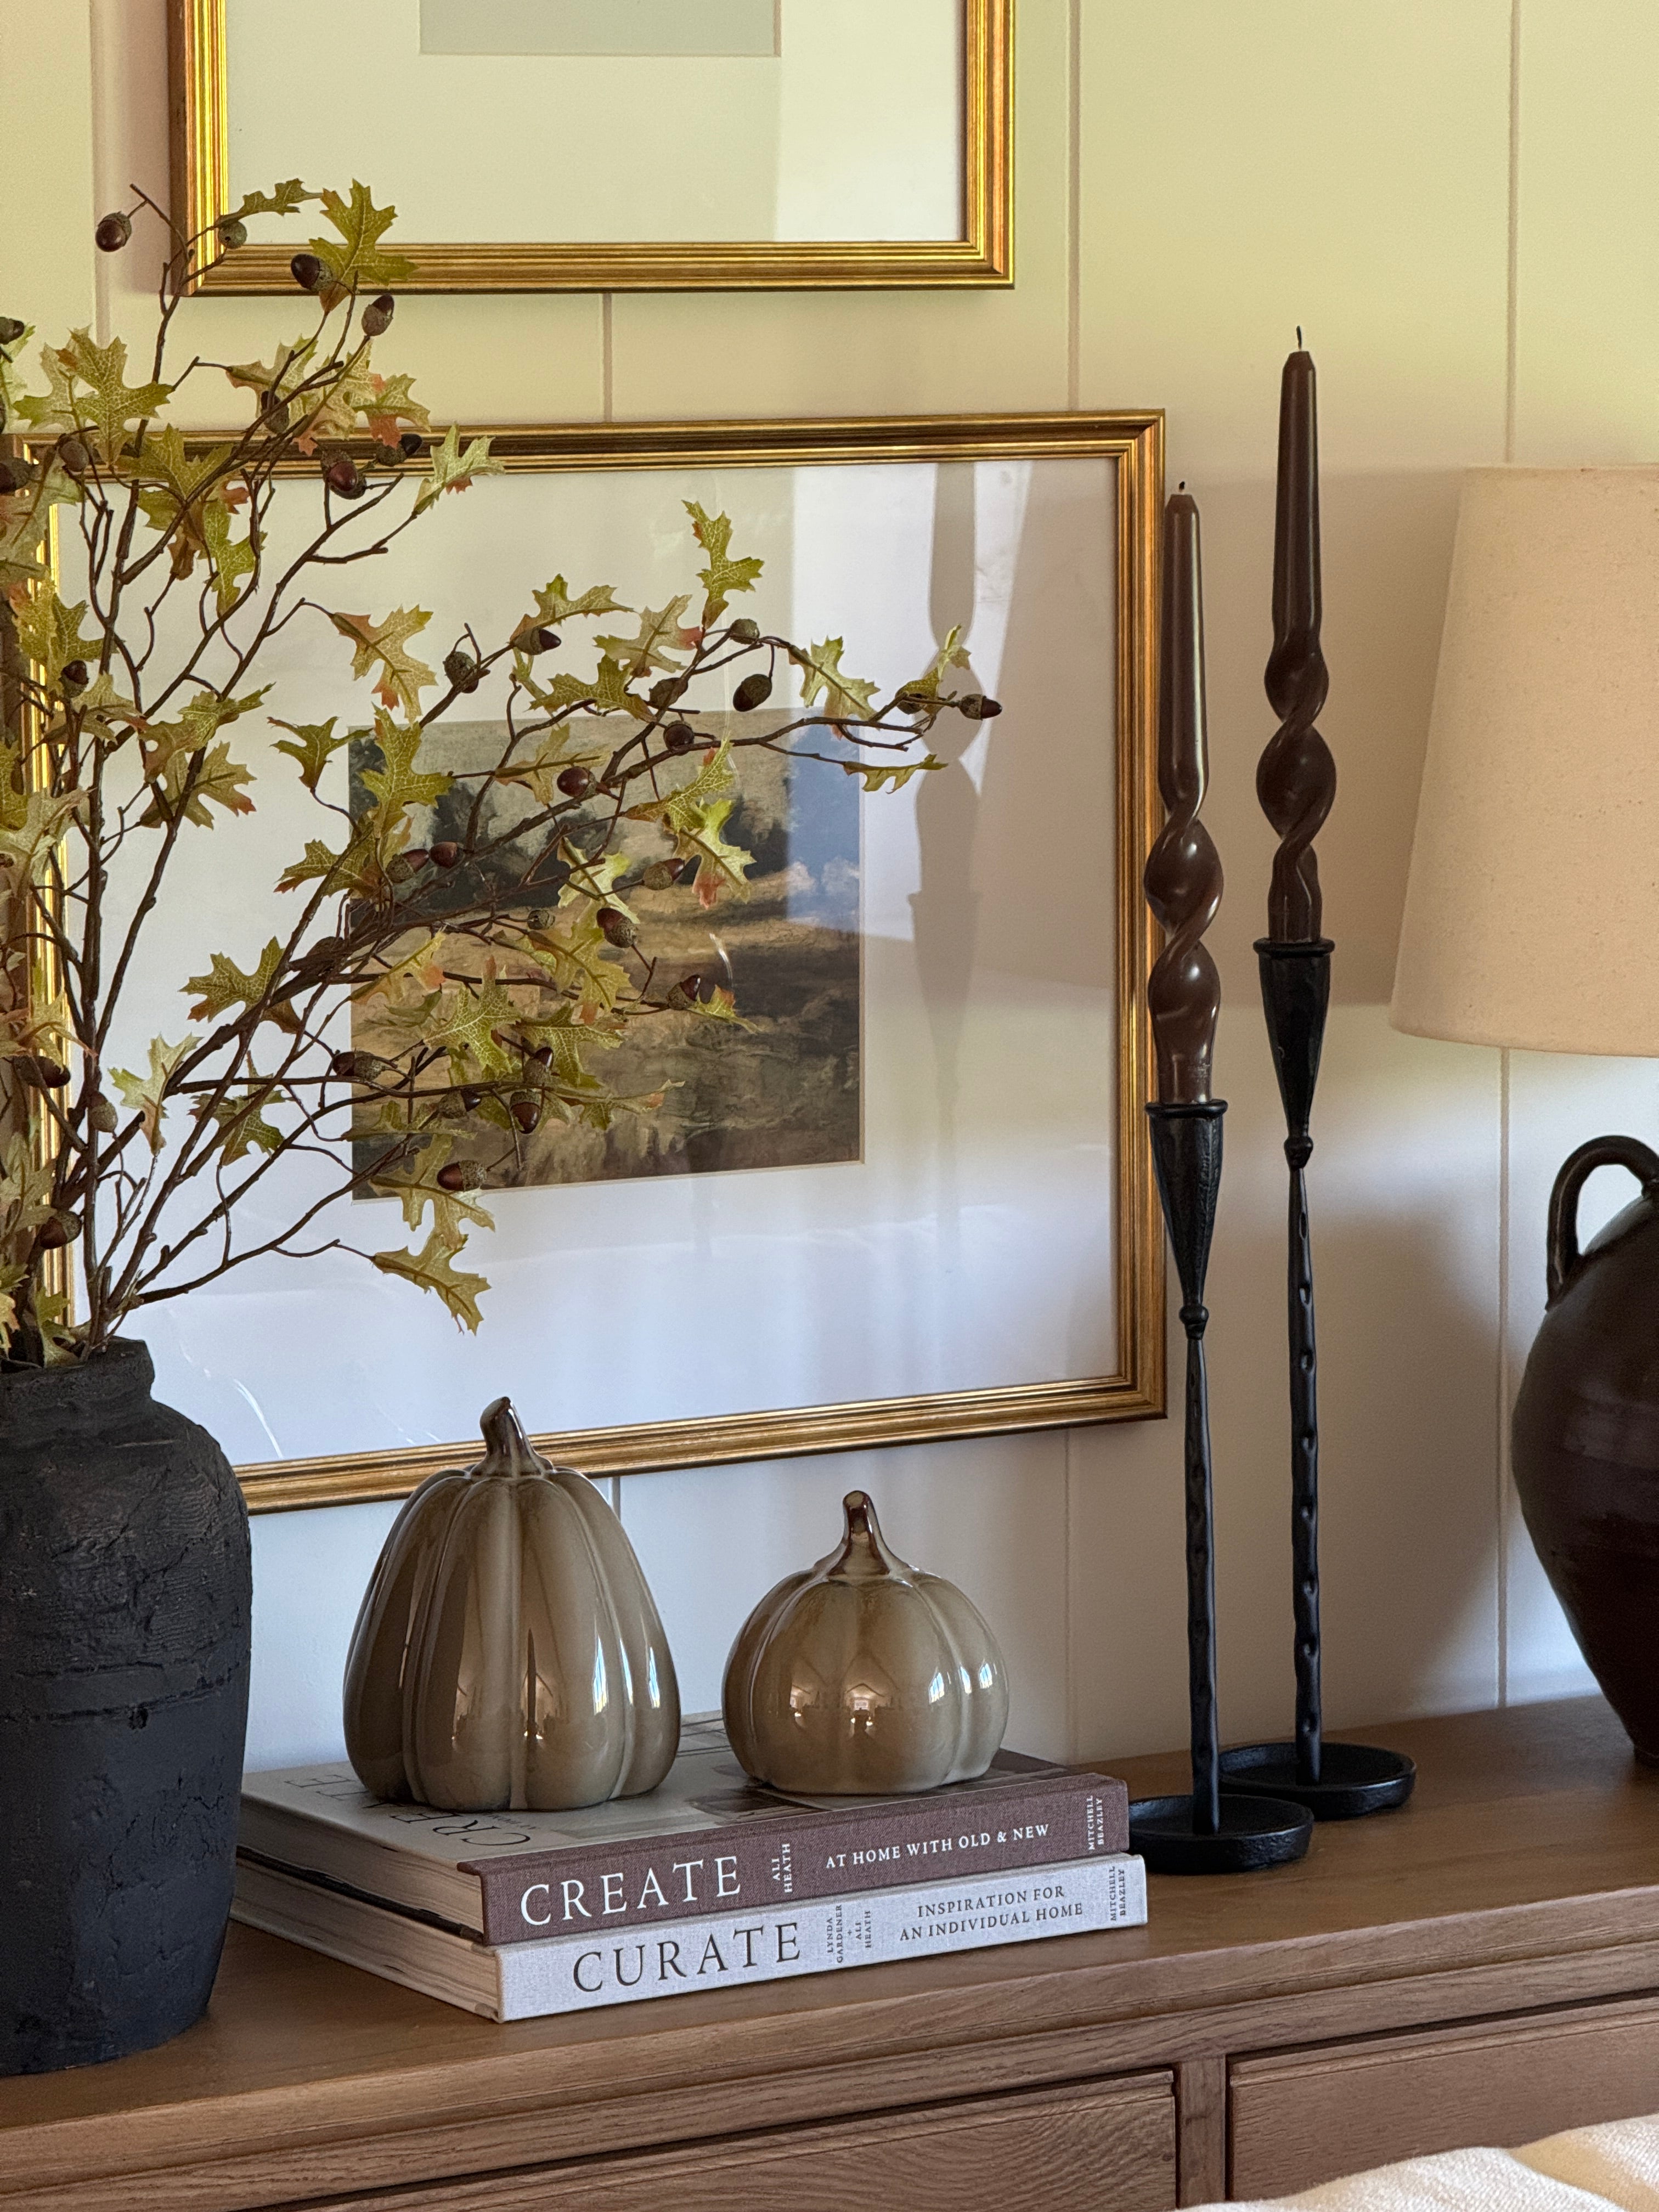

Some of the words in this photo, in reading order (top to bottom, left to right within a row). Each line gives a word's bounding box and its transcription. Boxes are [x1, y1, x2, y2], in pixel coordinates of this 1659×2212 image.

[826, 1854, 847, 1869] AT
[853, 1846, 901, 1865] HOME
[906, 1837, 952, 1857] WITH
[958, 1832, 991, 1849] OLD
[997, 1831, 1007, 1843] &
[1013, 1824, 1049, 1841] NEW
[1086, 1795, 1095, 1850] MITCHELL
[1096, 1798, 1104, 1846] BEAZLEY
[521, 1855, 741, 1926] CREATE
[771, 1858, 781, 1881] ALI
[781, 1843, 793, 1893] HEATH
[918, 1890, 1027, 1918] INSPIRATION
[1033, 1885, 1065, 1901] FOR
[1108, 1866, 1116, 1921] MITCHELL
[1118, 1869, 1126, 1917] BEAZLEY
[835, 1904, 844, 1963] GARDENER
[900, 1926, 922, 1941] AN
[928, 1911, 1030, 1937] INDIVIDUAL
[1036, 1903, 1083, 1921] HOME
[573, 1922, 800, 1993] CURATE
